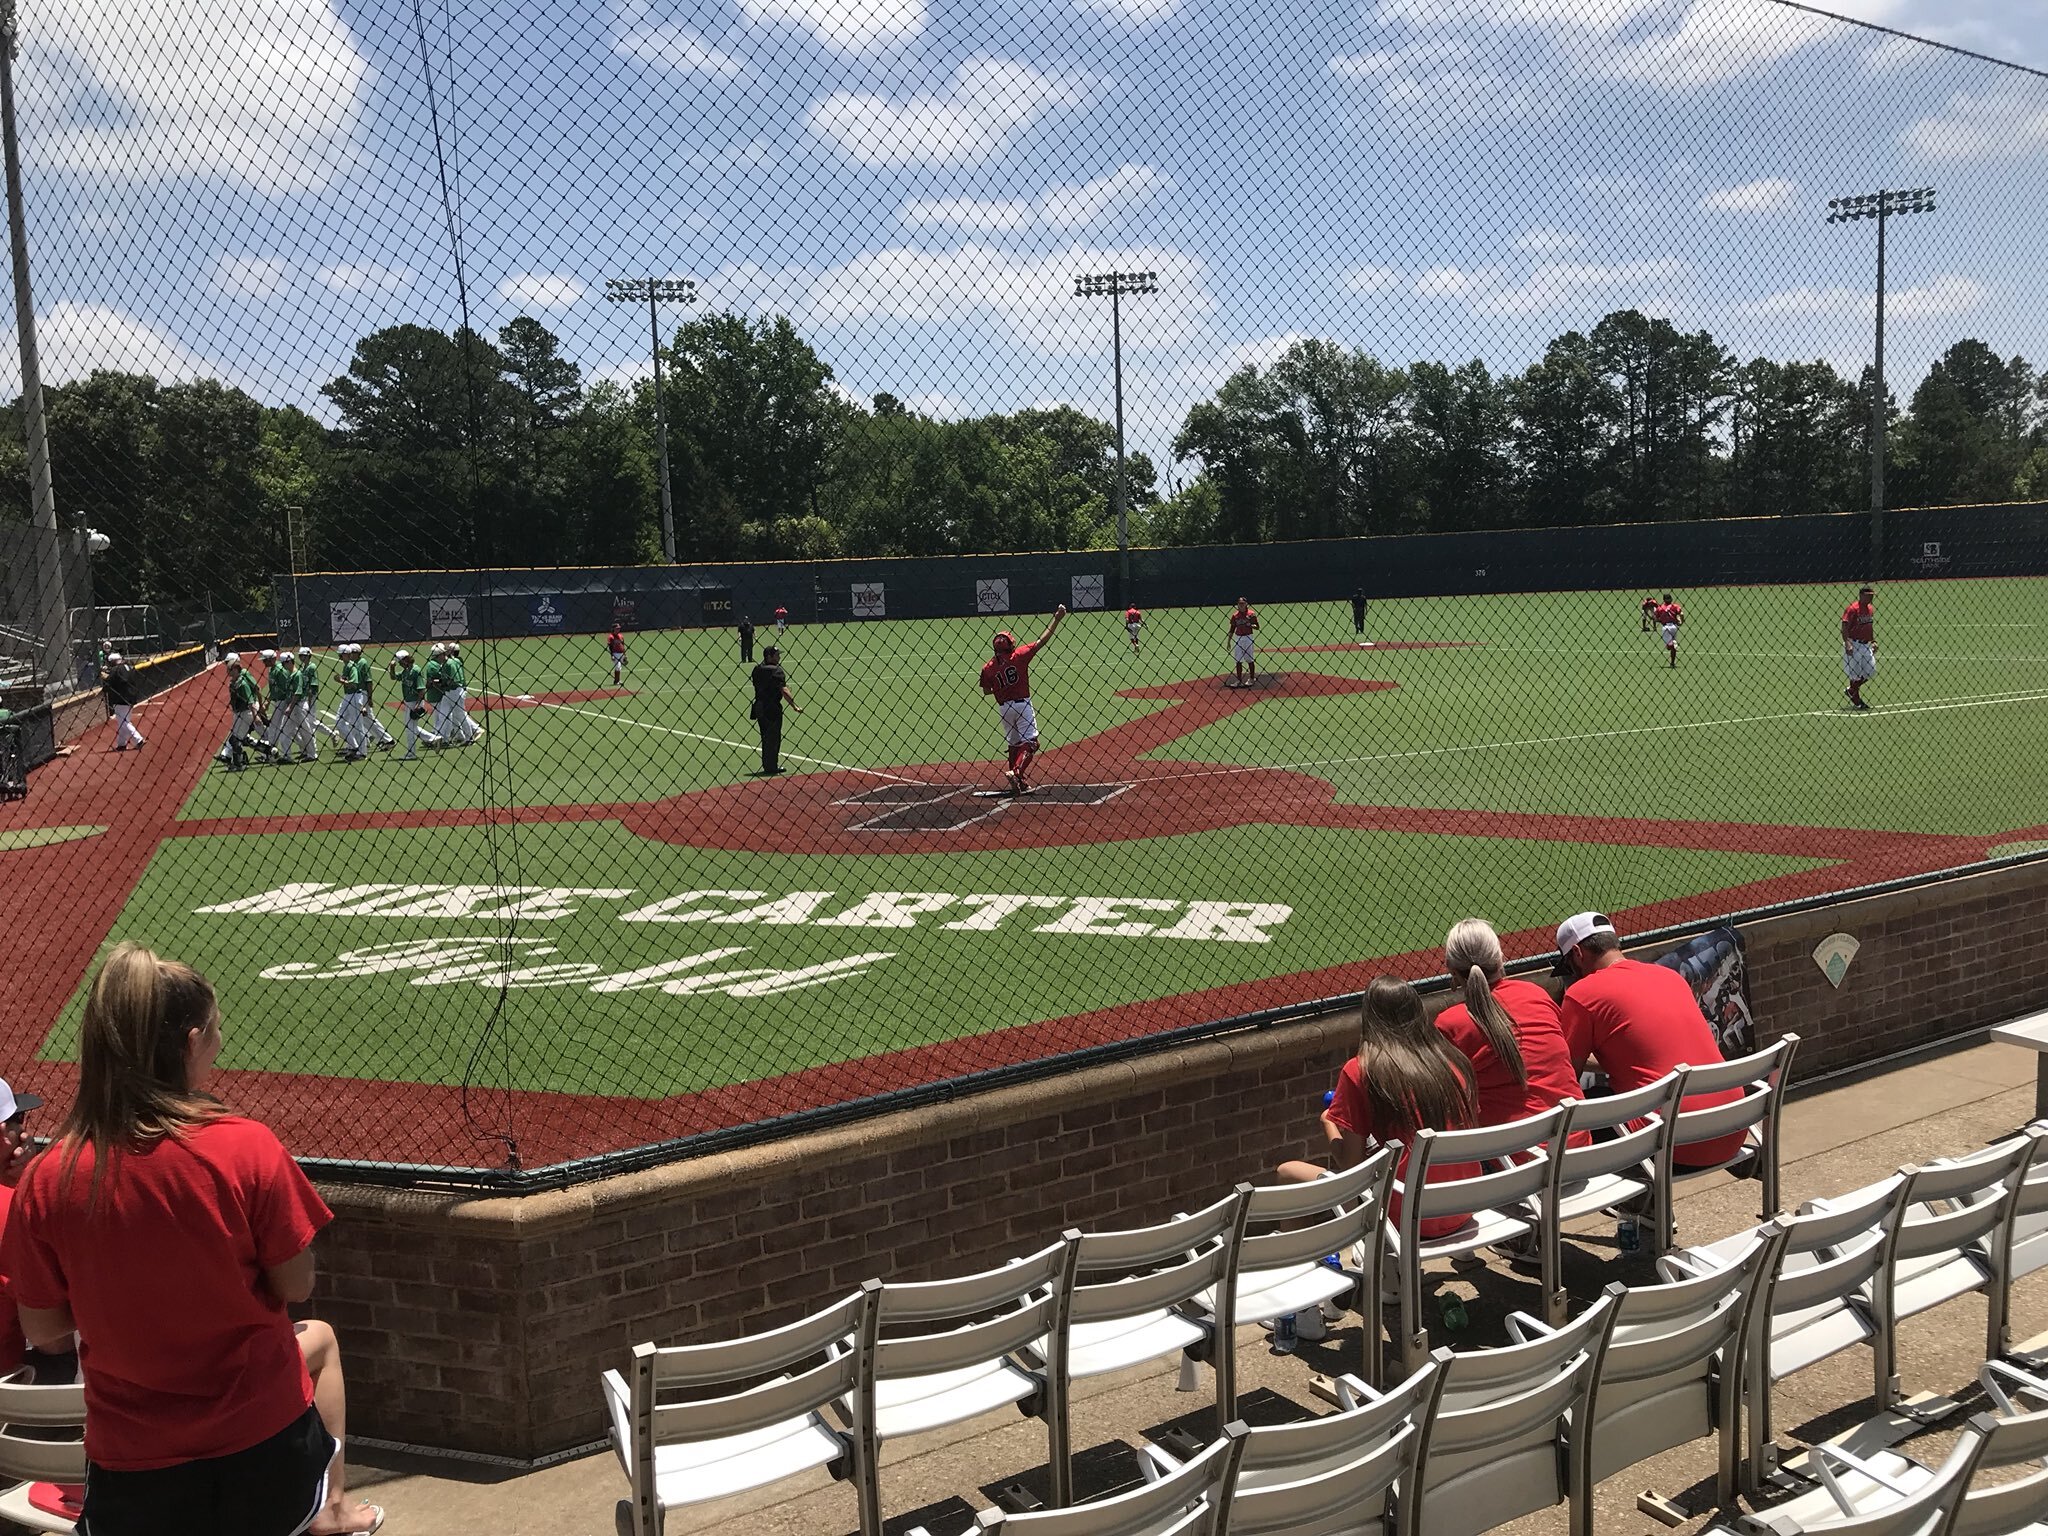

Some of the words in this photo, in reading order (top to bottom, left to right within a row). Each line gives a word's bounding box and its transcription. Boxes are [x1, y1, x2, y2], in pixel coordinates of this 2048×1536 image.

[995, 665, 1019, 688] 16
[192, 882, 638, 920] MIKE
[618, 890, 1293, 943] CARTER
[258, 936, 898, 997] Field
